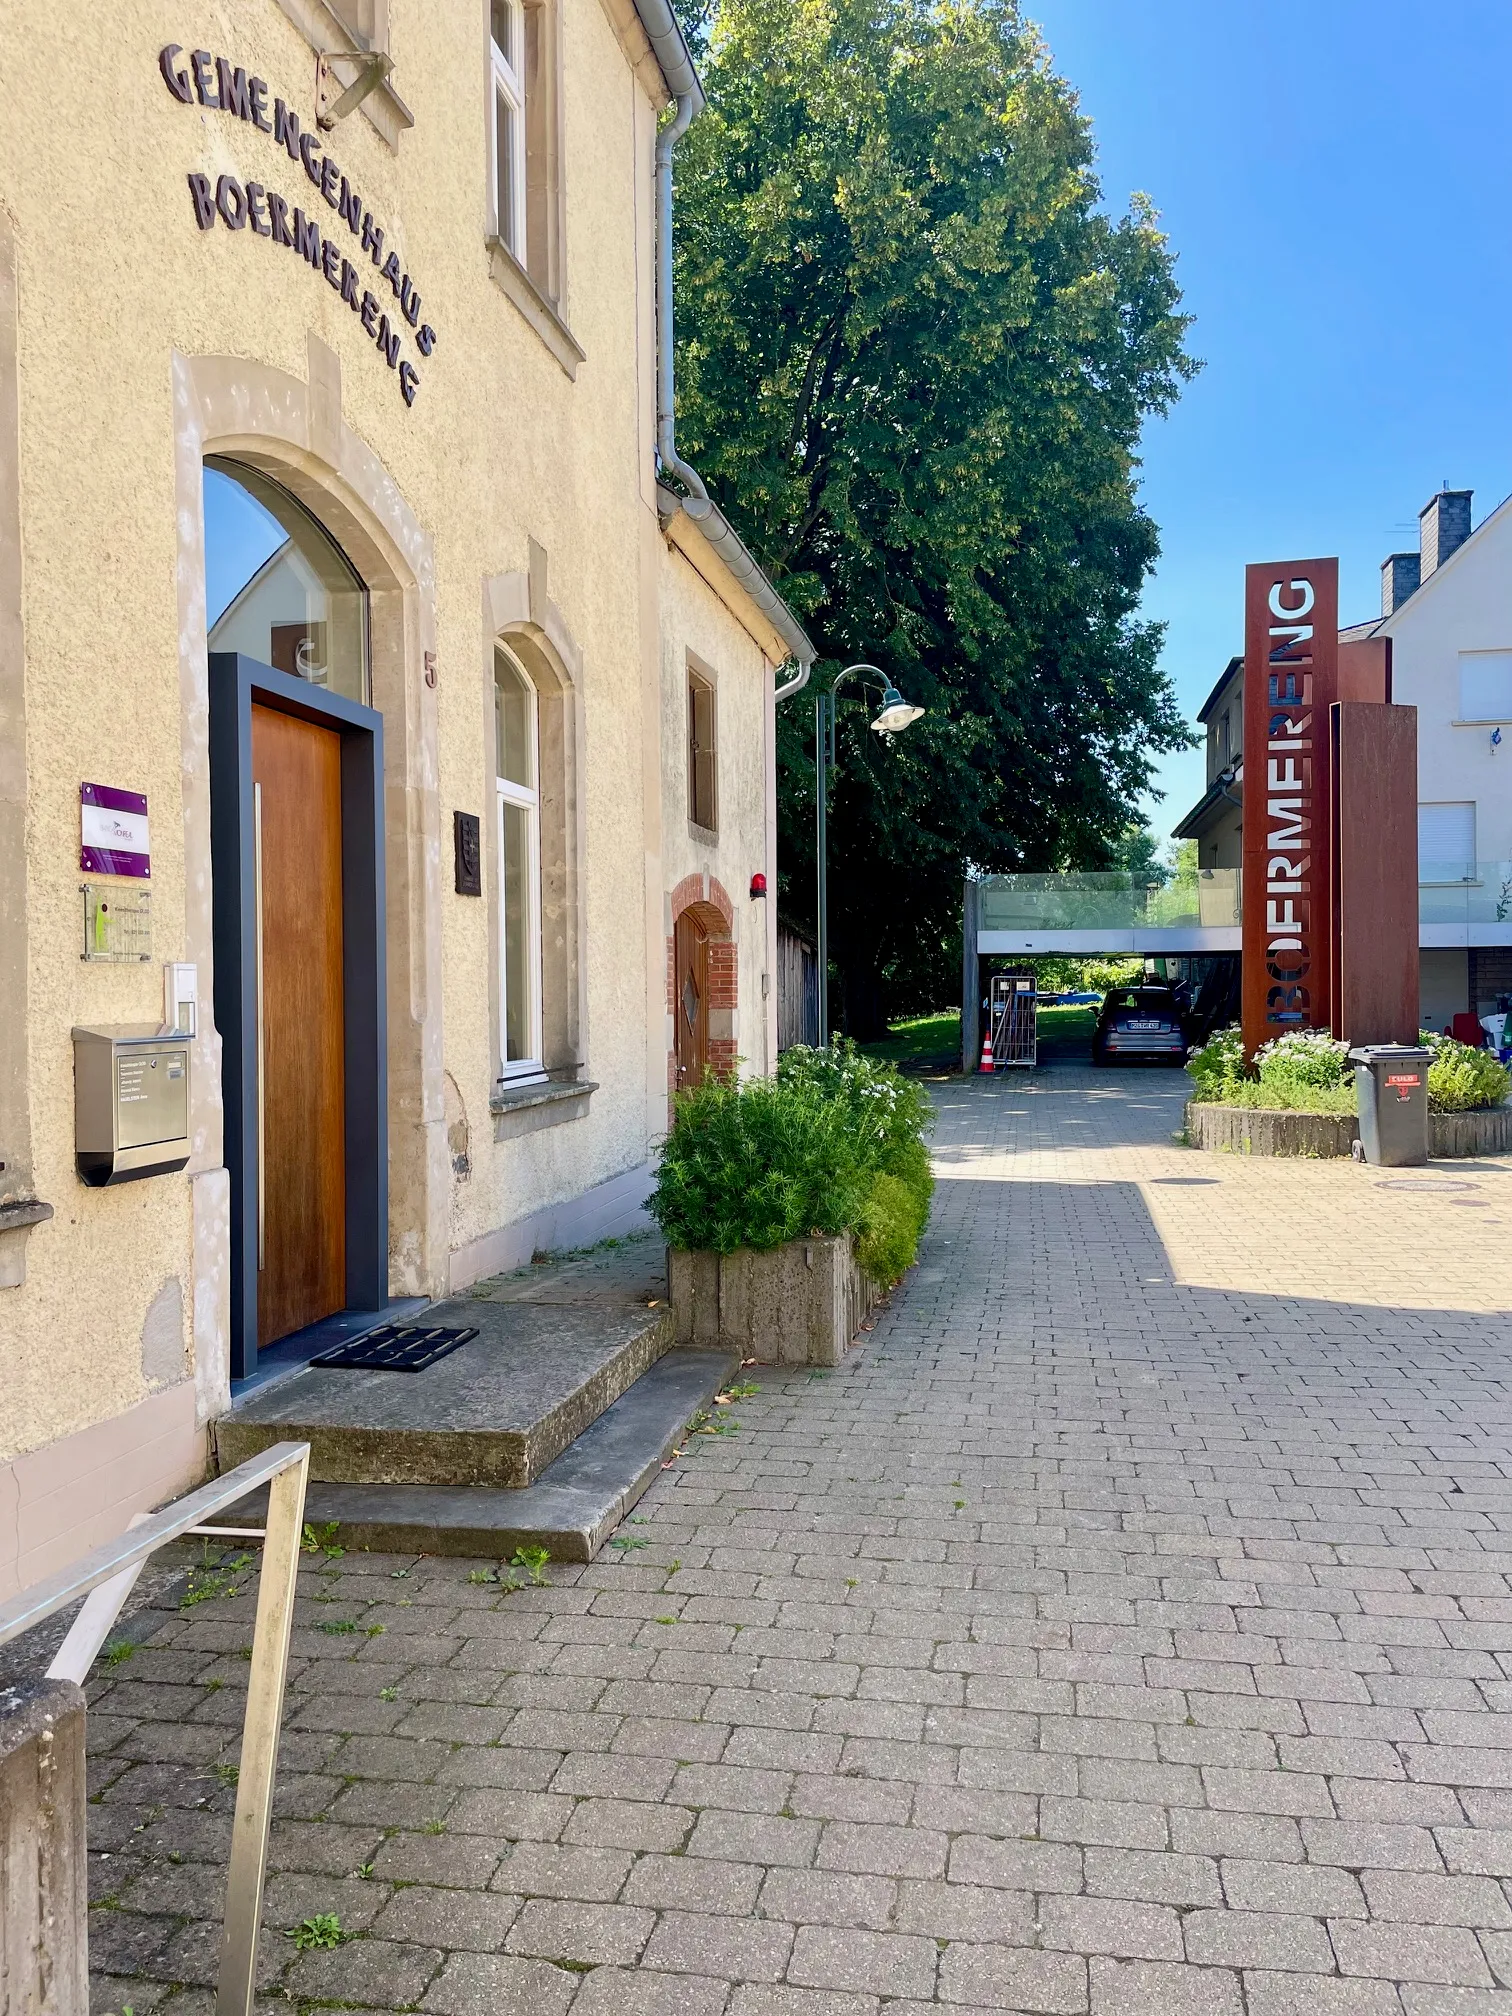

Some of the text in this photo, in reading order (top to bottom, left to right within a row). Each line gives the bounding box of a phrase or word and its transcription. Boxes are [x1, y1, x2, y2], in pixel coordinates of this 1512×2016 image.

[159, 43, 436, 357] GEMENGENHAUS
[187, 172, 420, 408] BOERMERENG
[424, 650, 438, 689] 5
[1265, 577, 1315, 1024] BOERMERENG
